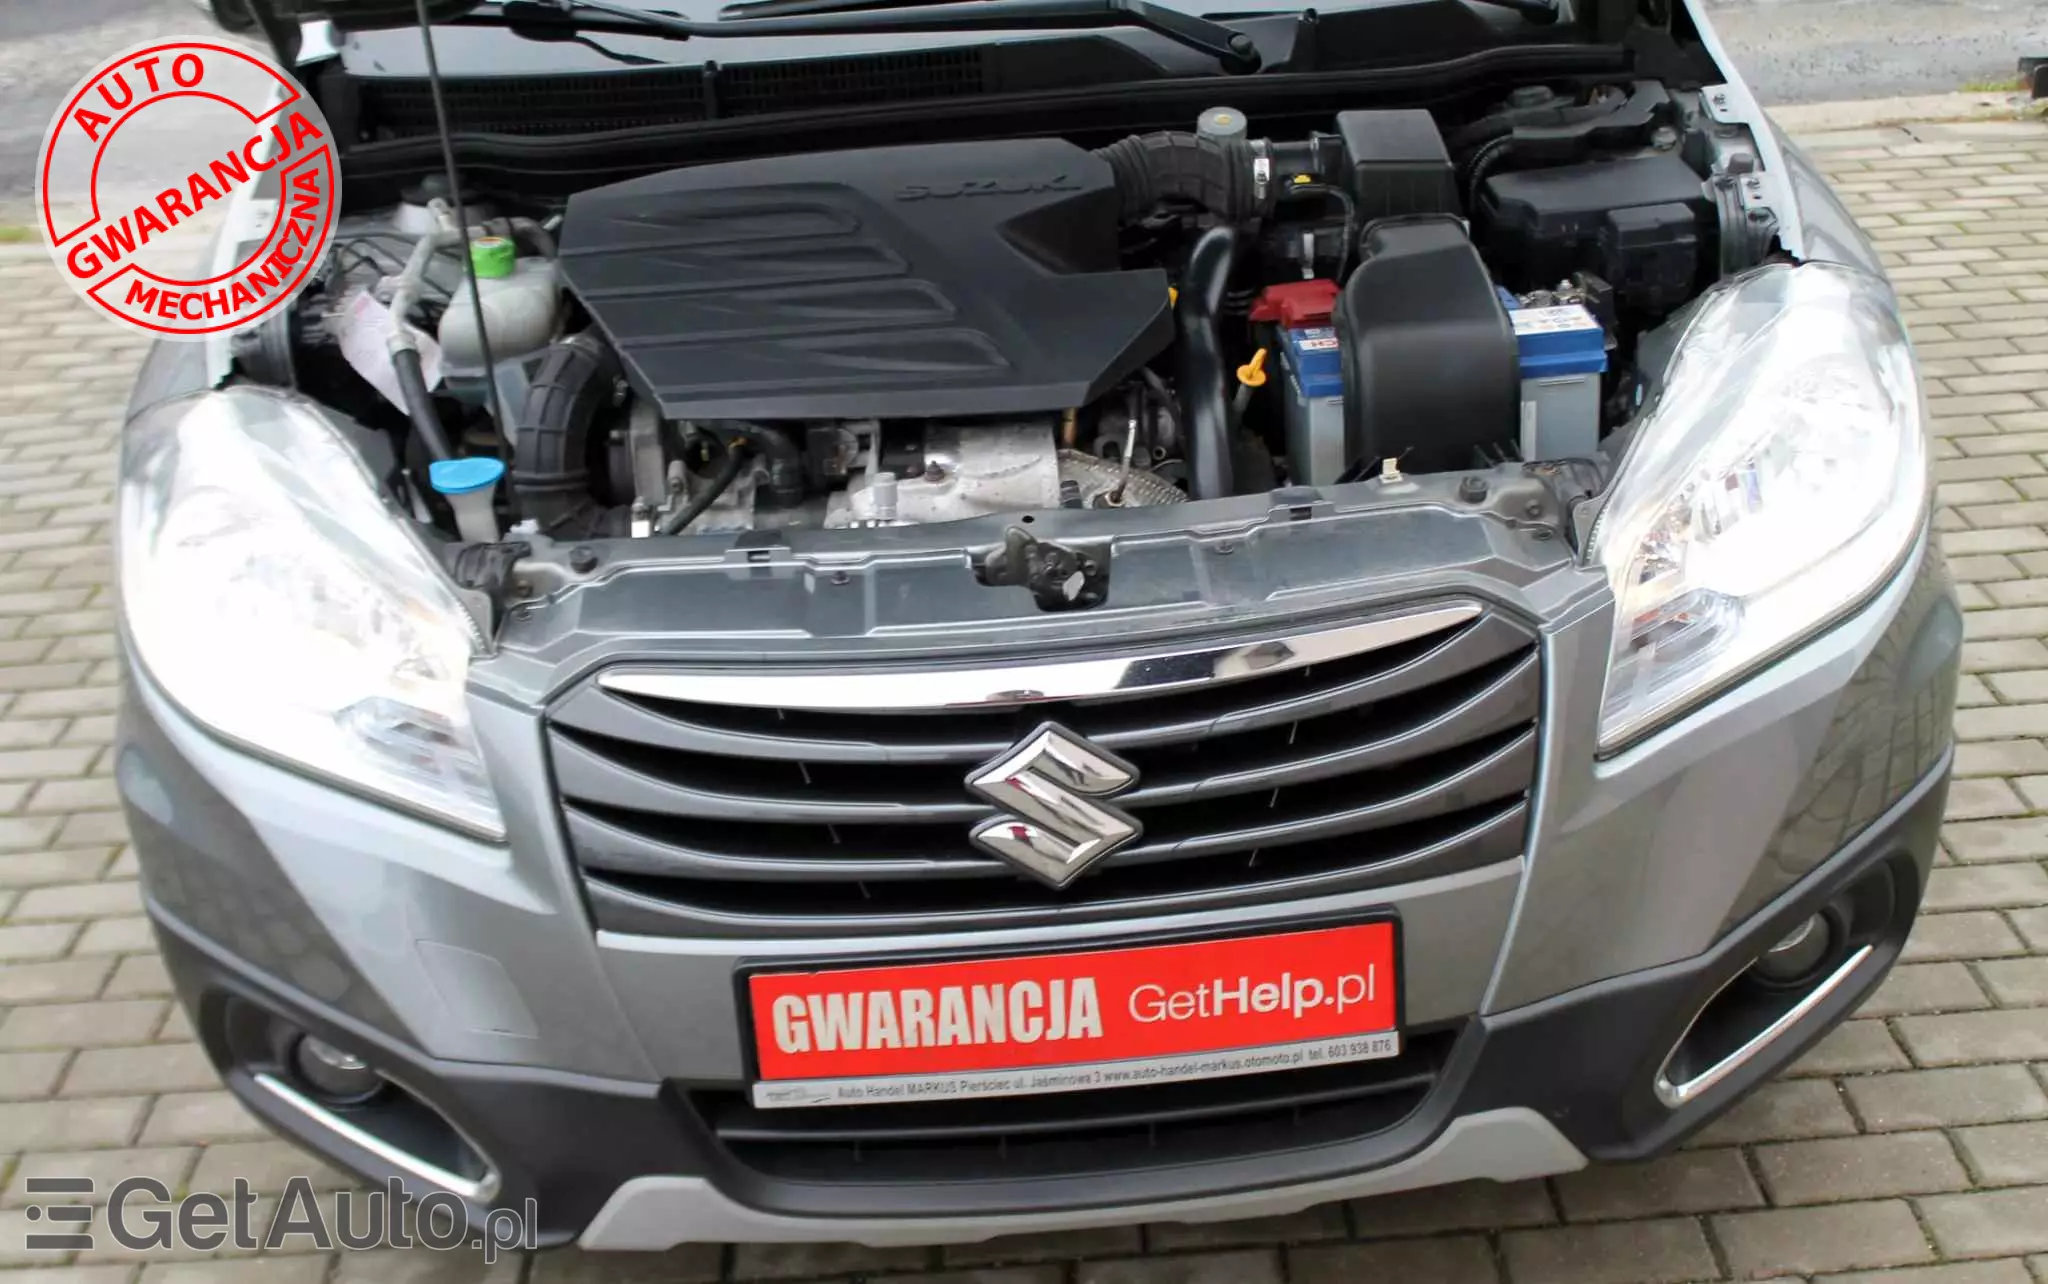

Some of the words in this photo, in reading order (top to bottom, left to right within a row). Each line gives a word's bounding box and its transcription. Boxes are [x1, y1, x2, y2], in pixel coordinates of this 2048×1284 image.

[771, 977, 1104, 1055] GWARANCJA
[1128, 963, 1376, 1023] GetHelp.pl
[838, 1086, 863, 1098] Auto
[866, 1085, 903, 1097] Handel
[907, 1080, 957, 1094] MARKUS
[1104, 1051, 1304, 1082] www.auto-handel-markus.otomoto.pl
[1308, 1048, 1323, 1060] tel.
[1328, 1045, 1347, 1058] 603
[1351, 1042, 1369, 1055] 938
[1372, 1039, 1392, 1052] 876
